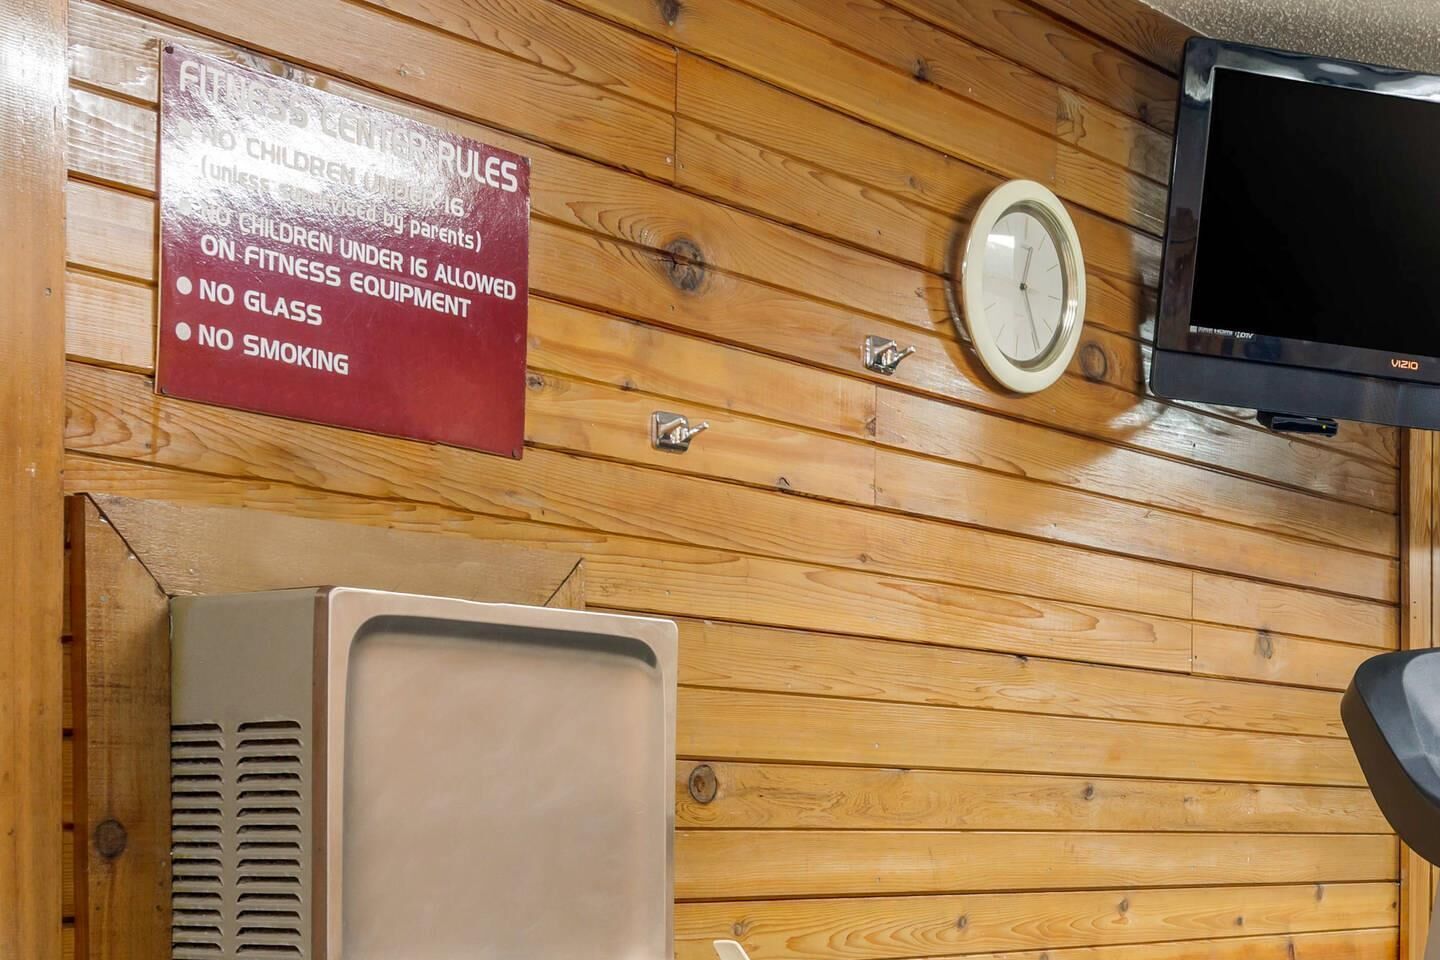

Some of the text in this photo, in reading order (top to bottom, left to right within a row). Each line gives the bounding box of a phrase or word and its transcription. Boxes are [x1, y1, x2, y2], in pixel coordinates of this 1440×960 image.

[179, 60, 518, 193] FITNESS CENTER RULES
[201, 126, 466, 218] NO CHILDREN UNDER 16
[201, 154, 271, 193] (unless
[384, 207, 404, 235] by
[410, 219, 482, 253] parents)
[200, 203, 517, 301] NO CHILDREN UNDER 16 ALLOWED
[200, 234, 472, 319] ON FITNESS EQUIPMENT
[199, 278, 323, 326] NO GLASS
[198, 323, 350, 376] NO SMOKING
[1391, 358, 1419, 371] VIZIO
